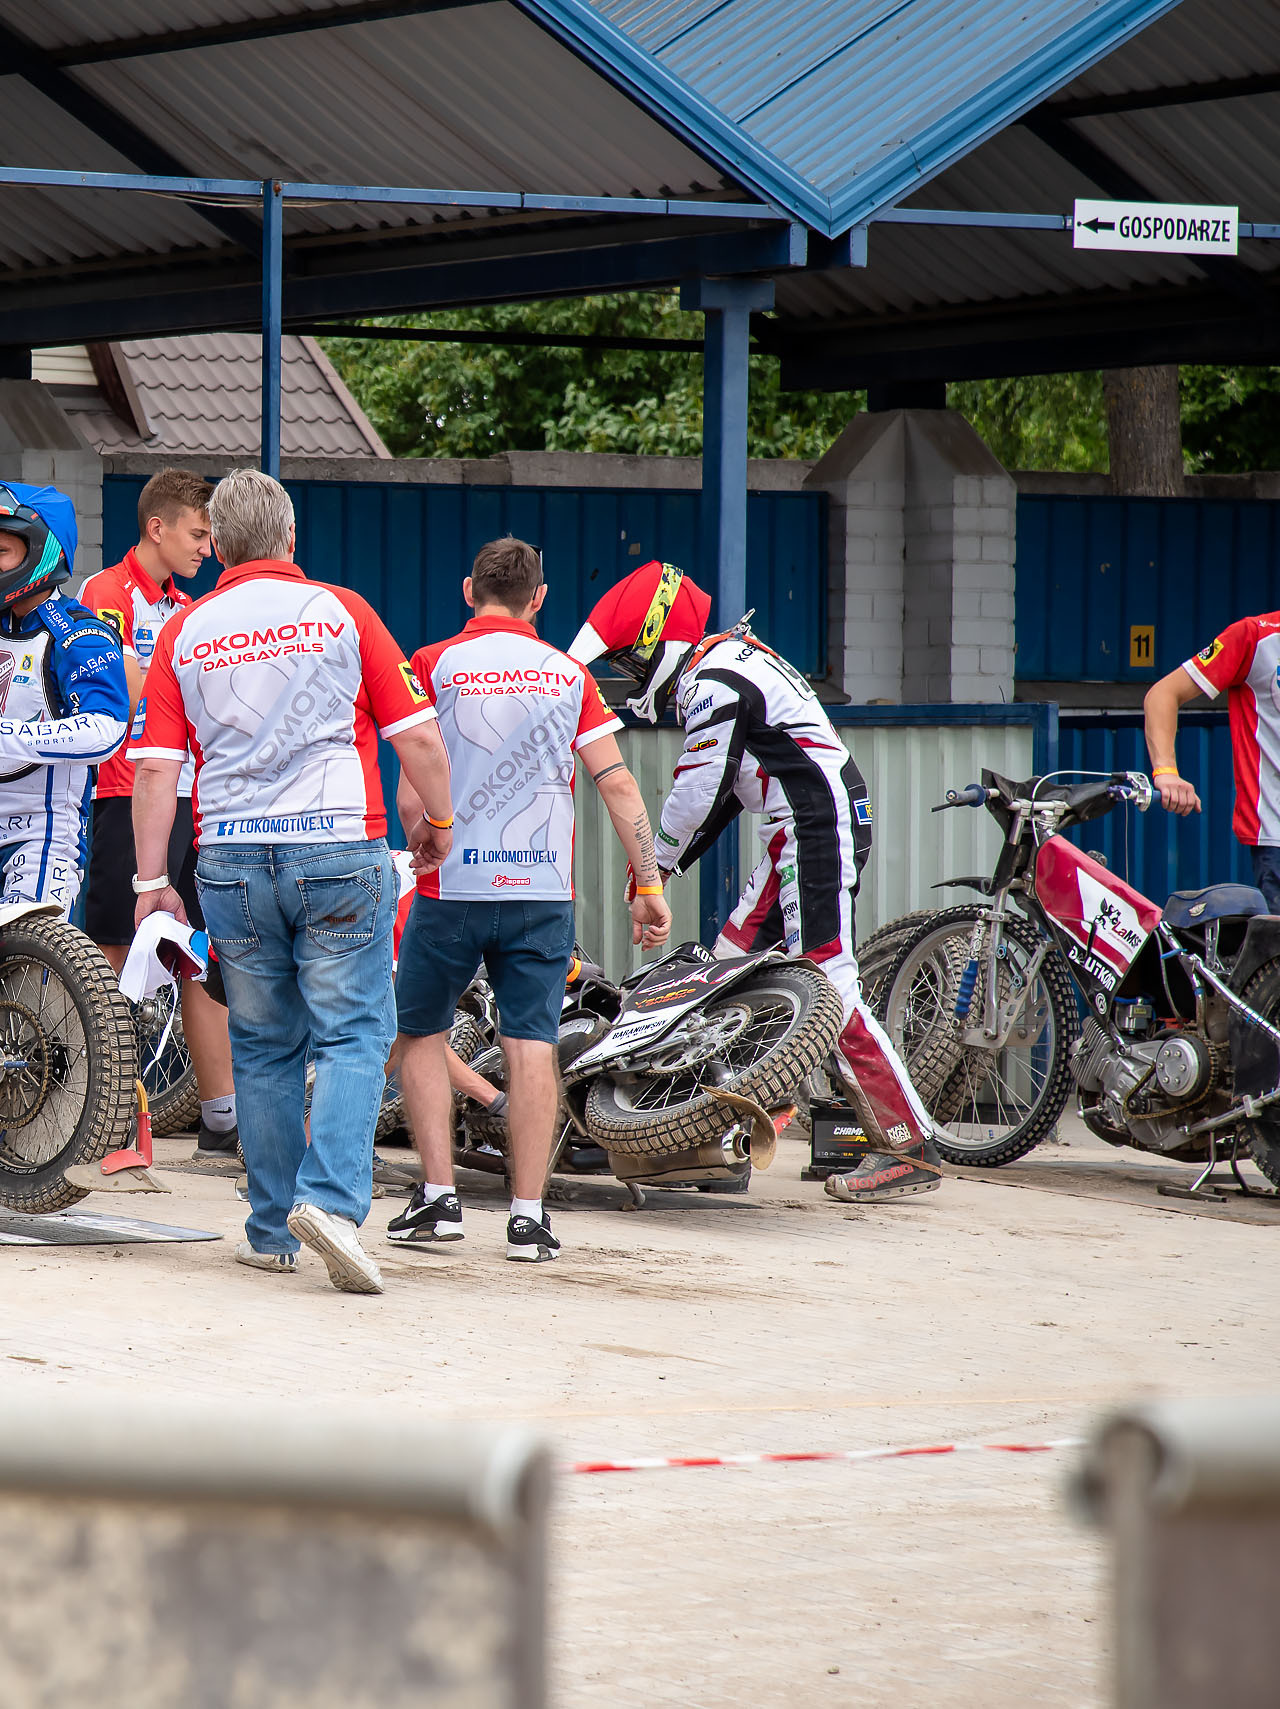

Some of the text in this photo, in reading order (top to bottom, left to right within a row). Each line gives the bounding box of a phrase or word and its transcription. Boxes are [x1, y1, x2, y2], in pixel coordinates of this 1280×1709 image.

[1120, 216, 1231, 242] GOSPODARZE
[4, 572, 52, 603] SCOTT
[45, 602, 71, 635] SAGARI
[179, 622, 345, 667] LOKOMOTIV
[203, 643, 325, 673] DAUGAVPILS
[1133, 634, 1150, 658] 11
[70, 651, 121, 681] SAGARI
[440, 669, 578, 690] LOKOMOTIV
[460, 685, 561, 697] DAUGAVPILS
[27, 736, 75, 747] SPORTS
[211, 643, 350, 813] LOKOMOTIV
[455, 695, 581, 826] LOKOMOTIV
[239, 816, 335, 834] LOKOMOTIVE.LV
[482, 850, 558, 863] LOKOMOTIVE.LV
[847, 1164, 914, 1191] daytona
